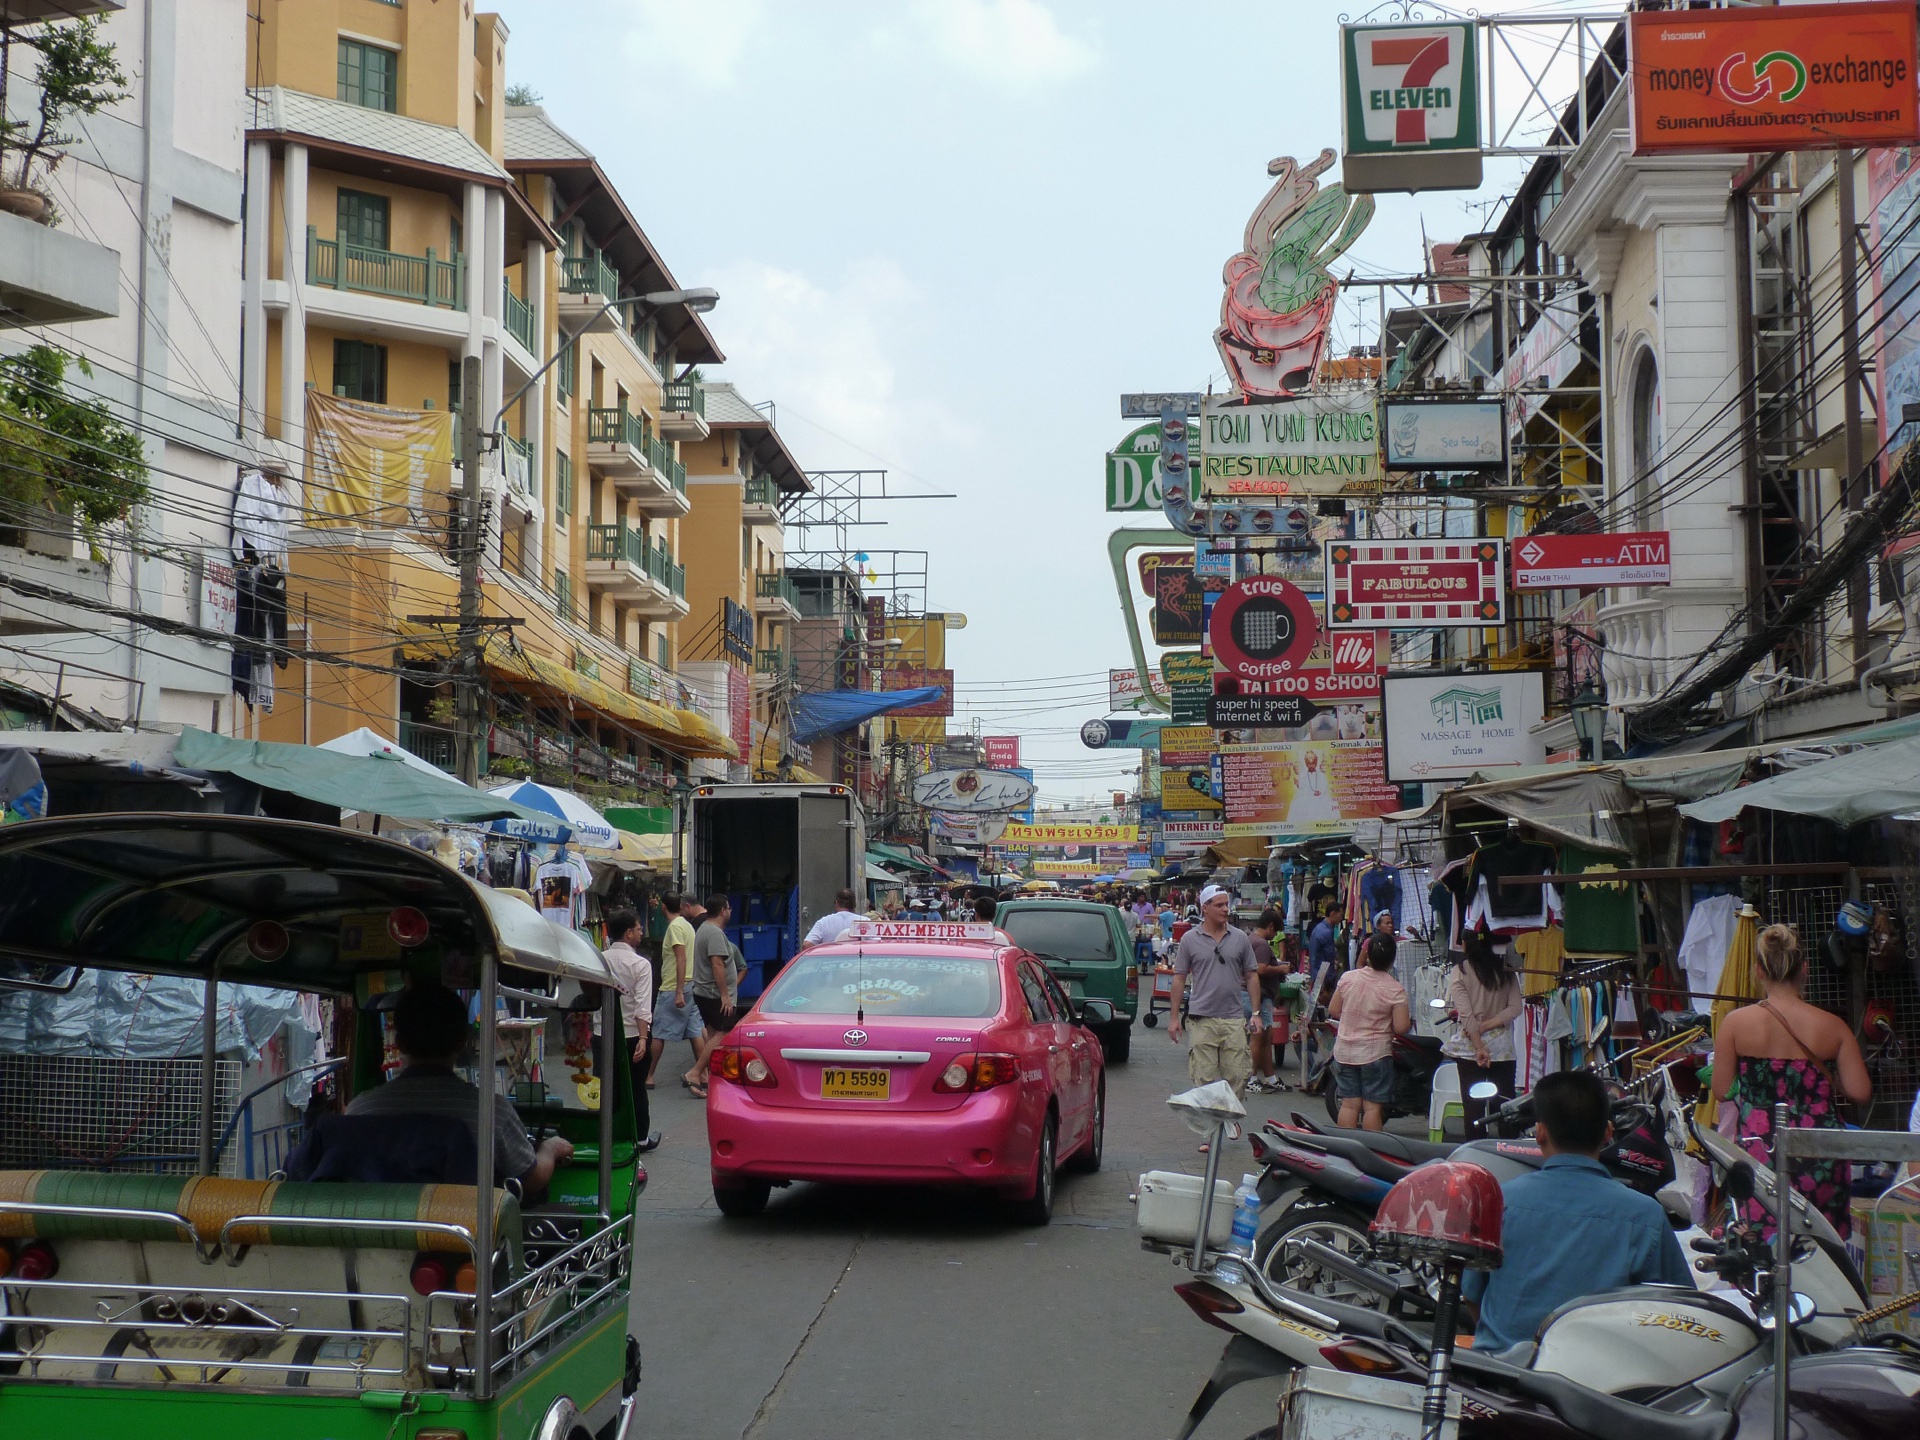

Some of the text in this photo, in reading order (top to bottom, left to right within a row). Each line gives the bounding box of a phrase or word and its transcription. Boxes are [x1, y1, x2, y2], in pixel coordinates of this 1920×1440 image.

[1650, 55, 1907, 96] money exchange
[1371, 35, 1449, 143] 7
[1656, 109, 1900, 130] รับแลกเปลี่ยนเงินตราต่างประเทศ
[1206, 412, 1375, 443] TOM YUM KUNG
[1441, 437, 1459, 448] Sea
[1205, 455, 1373, 477] RESTAURANT
[1228, 481, 1289, 493] SEA FOOD
[1617, 543, 1666, 564] ATM
[1400, 565, 1429, 576] THE
[1530, 573, 1571, 582] CIMB THAI
[1653, 569, 1666, 579] ไทย
[1241, 581, 1284, 596] true
[1362, 577, 1468, 591] FABULOUS
[1335, 637, 1373, 670] illy
[1238, 660, 1292, 677] coffee
[1216, 698, 1299, 712] super hi speed
[1216, 711, 1302, 721] internet & wi fi
[1163, 729, 1190, 738] SUNNY
[1420, 728, 1515, 741] MASSAGE HOME
[1451, 745, 1483, 755] บ้านนวด
[919, 778, 1027, 803] The Club
[1012, 825, 1118, 839] ทรงพระเจริญ
[1165, 823, 1210, 832] INTERNET
[1008, 844, 1029, 852] BAG
[1045, 863, 1099, 871] ทรงพระเจริญ
[875, 923, 966, 937] TAXI-METER
[842, 978, 919, 996] 88888
[824, 1070, 887, 1087] ทว 5599
[1278, 1318, 1328, 1341] 200
[1638, 1312, 1721, 1342] BOXER
